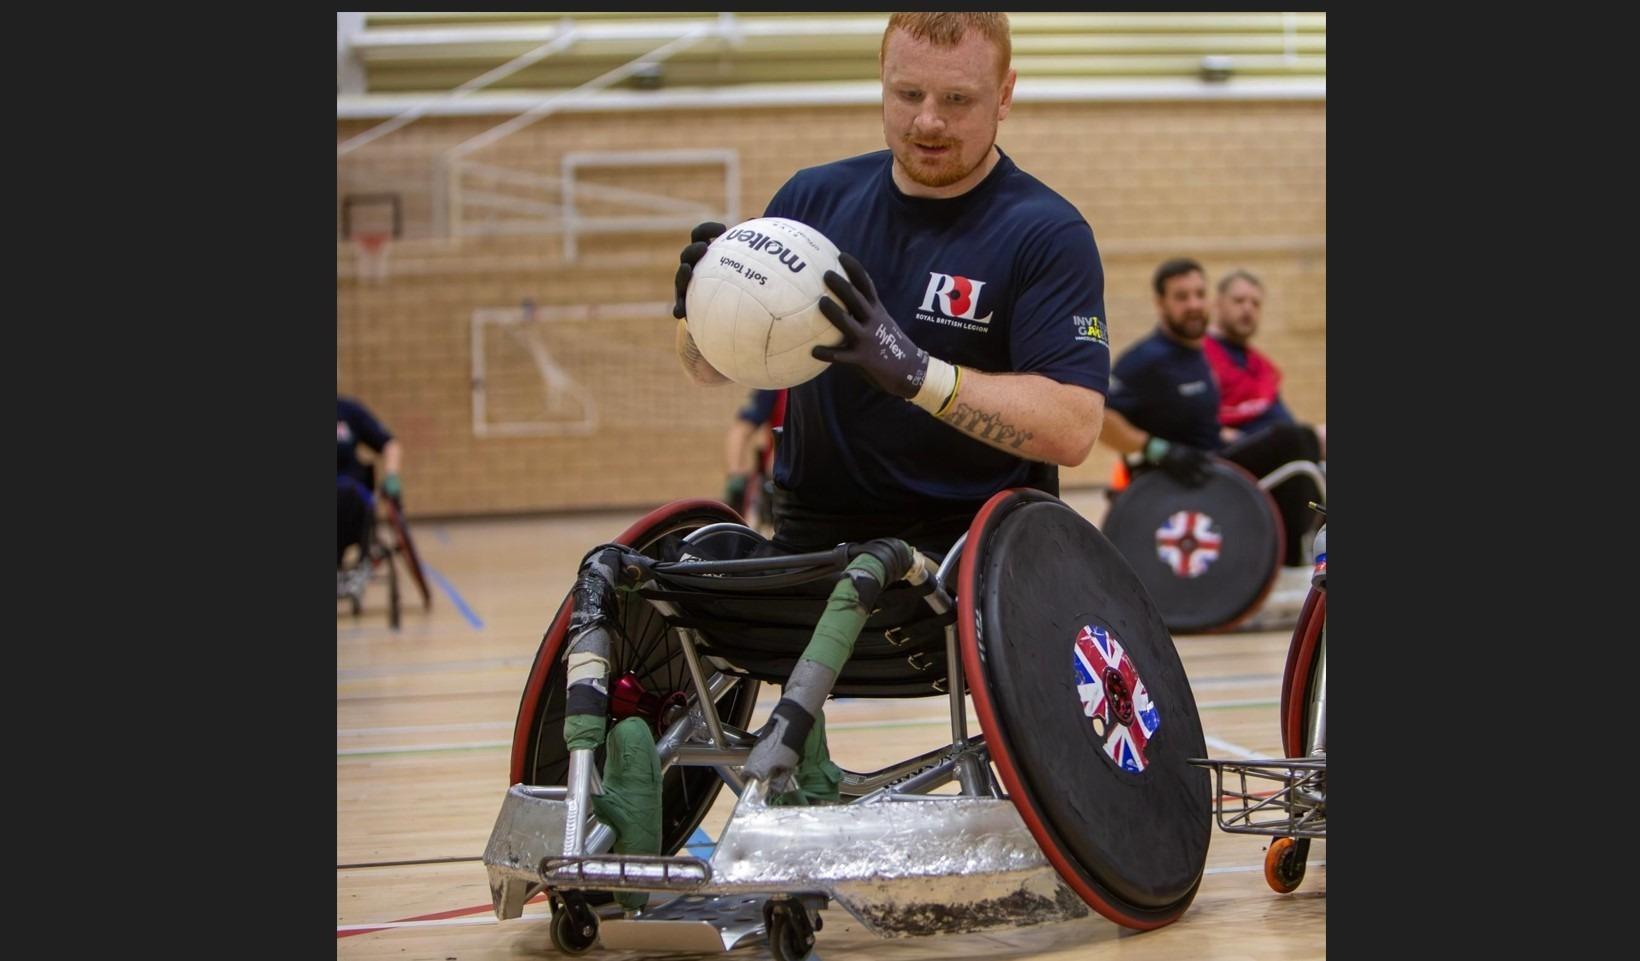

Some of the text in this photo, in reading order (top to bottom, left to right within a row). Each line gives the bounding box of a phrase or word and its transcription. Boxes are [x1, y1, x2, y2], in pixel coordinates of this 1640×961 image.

[726, 228, 807, 273] molten
[720, 255, 768, 286] Soft Touch
[915, 313, 989, 333] ROYAL BRITISH LEGION
